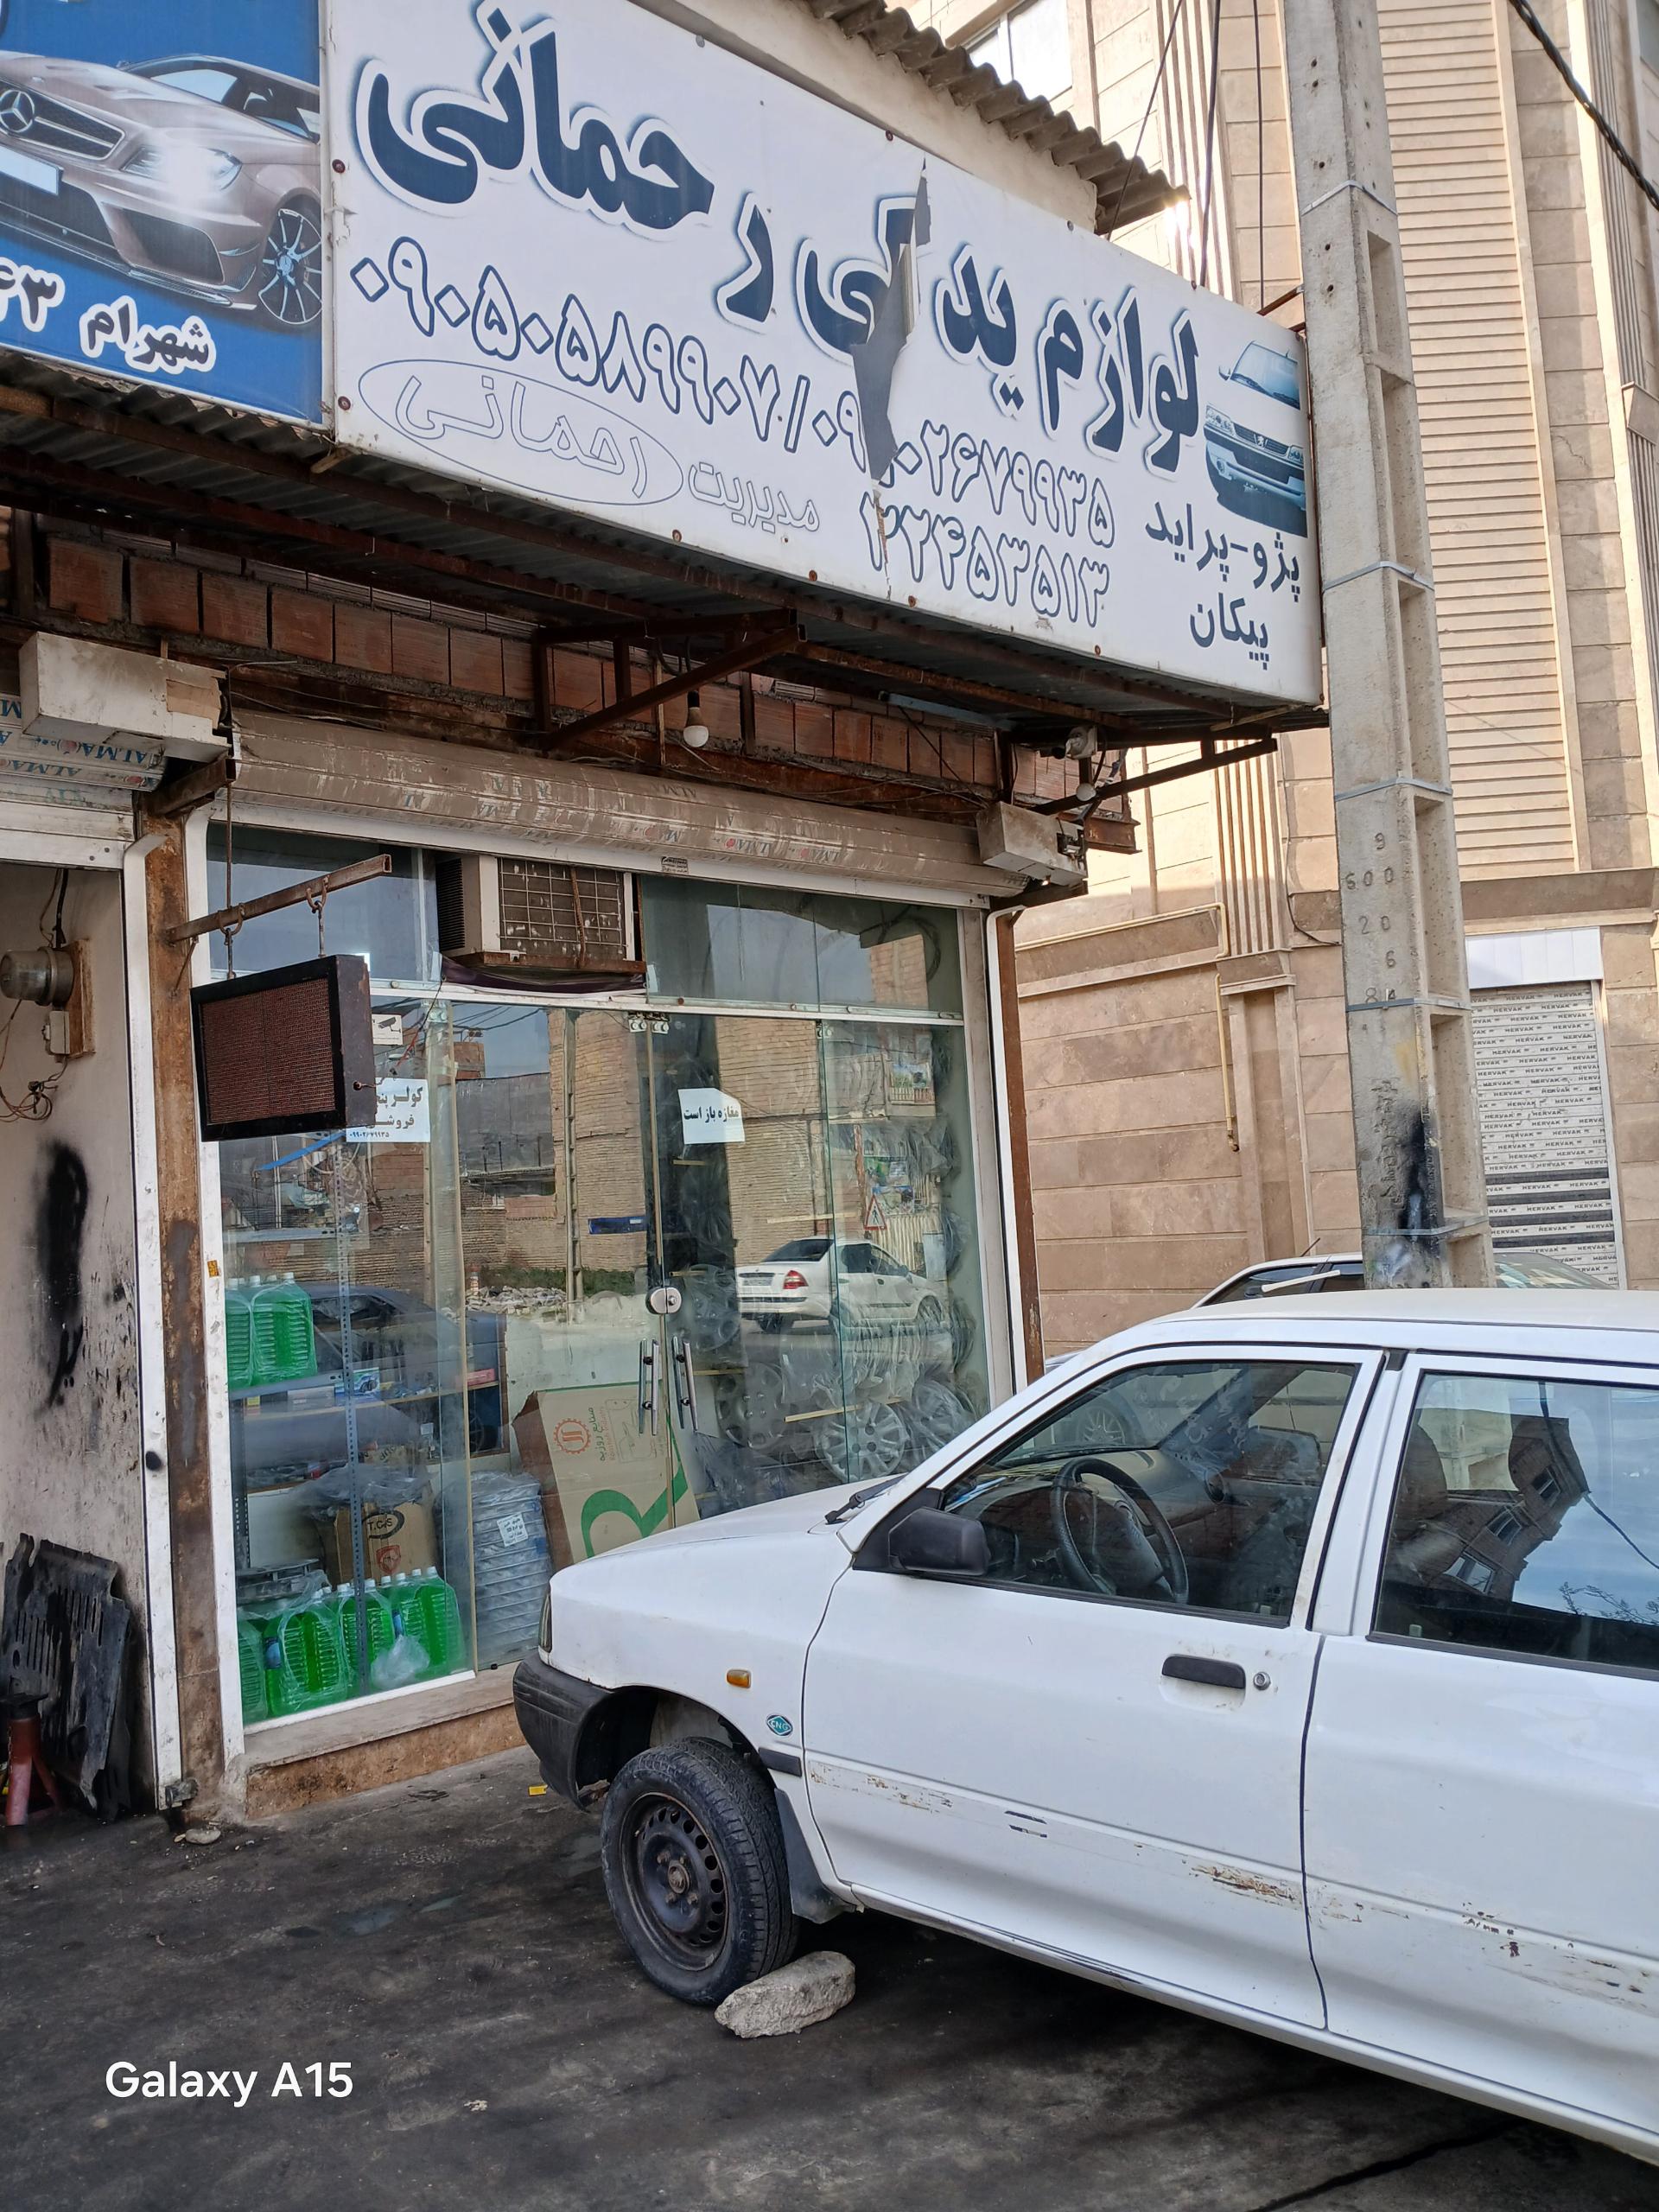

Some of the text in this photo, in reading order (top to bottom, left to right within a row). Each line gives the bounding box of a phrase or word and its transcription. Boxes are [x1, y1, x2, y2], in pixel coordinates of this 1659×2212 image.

[84, 302, 212, 368] شهرام
[1042, 295, 1200, 474] لوازم
[395, 375, 820, 534] مدیریت رحمانی
[1189, 592, 1269, 671] پیکان
[391, 1085, 423, 1108] کولر
[683, 1105, 740, 1123] مغازه باز است
[771, 1719, 788, 1730] CNG
